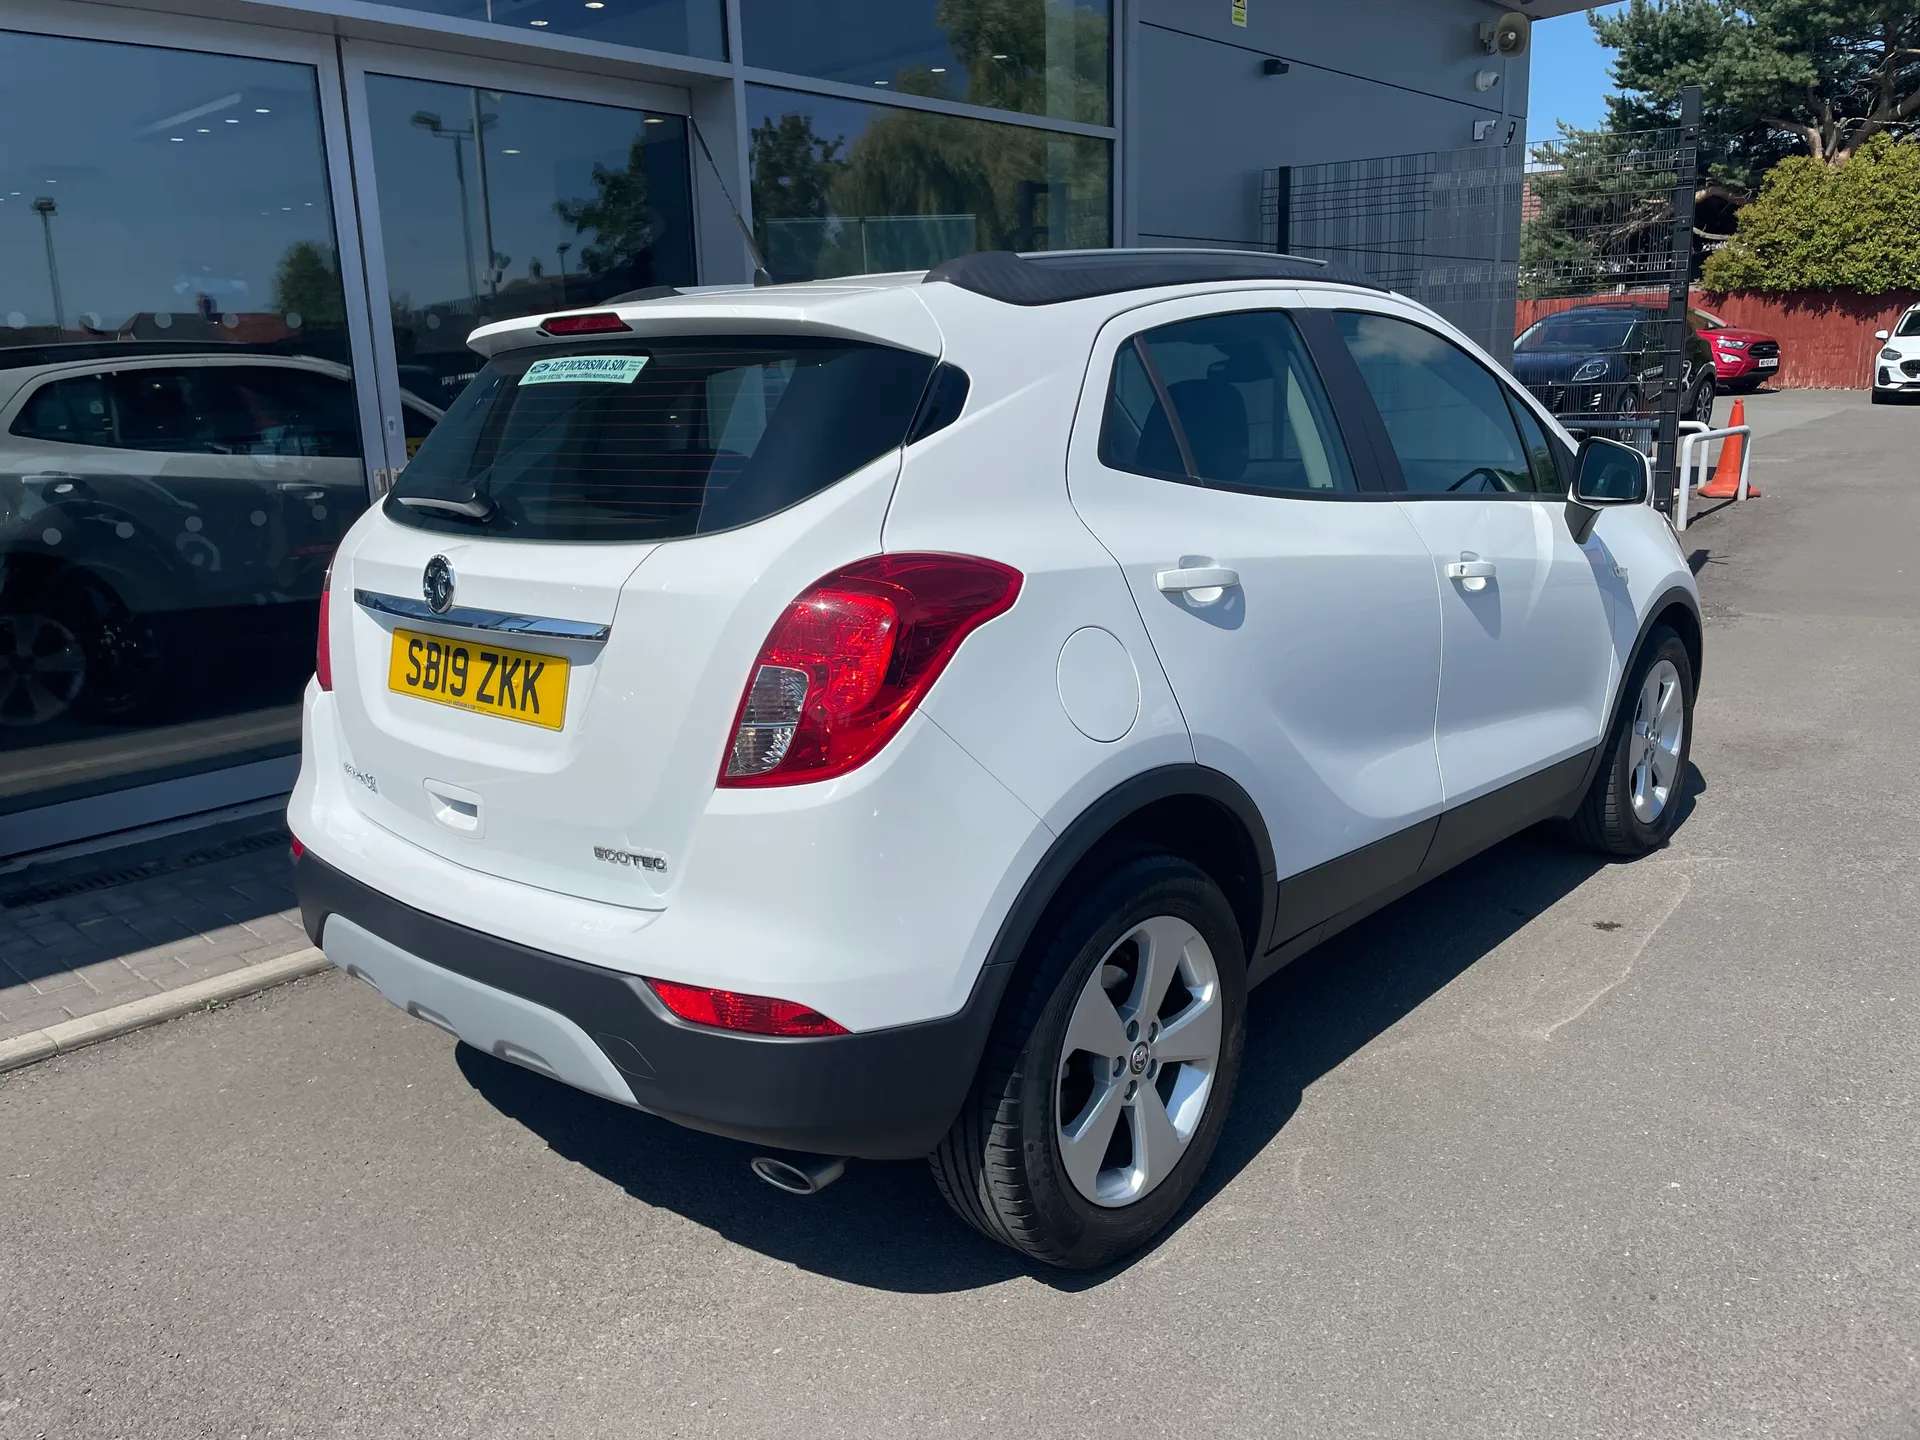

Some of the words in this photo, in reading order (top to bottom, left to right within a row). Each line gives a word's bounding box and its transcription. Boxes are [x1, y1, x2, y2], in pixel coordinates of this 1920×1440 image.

[549, 360, 572, 372] CLIFF
[609, 359, 629, 371] SON
[405, 638, 470, 698] SB19
[476, 651, 545, 715] ZKK
[593, 846, 668, 873] ECOTEC
